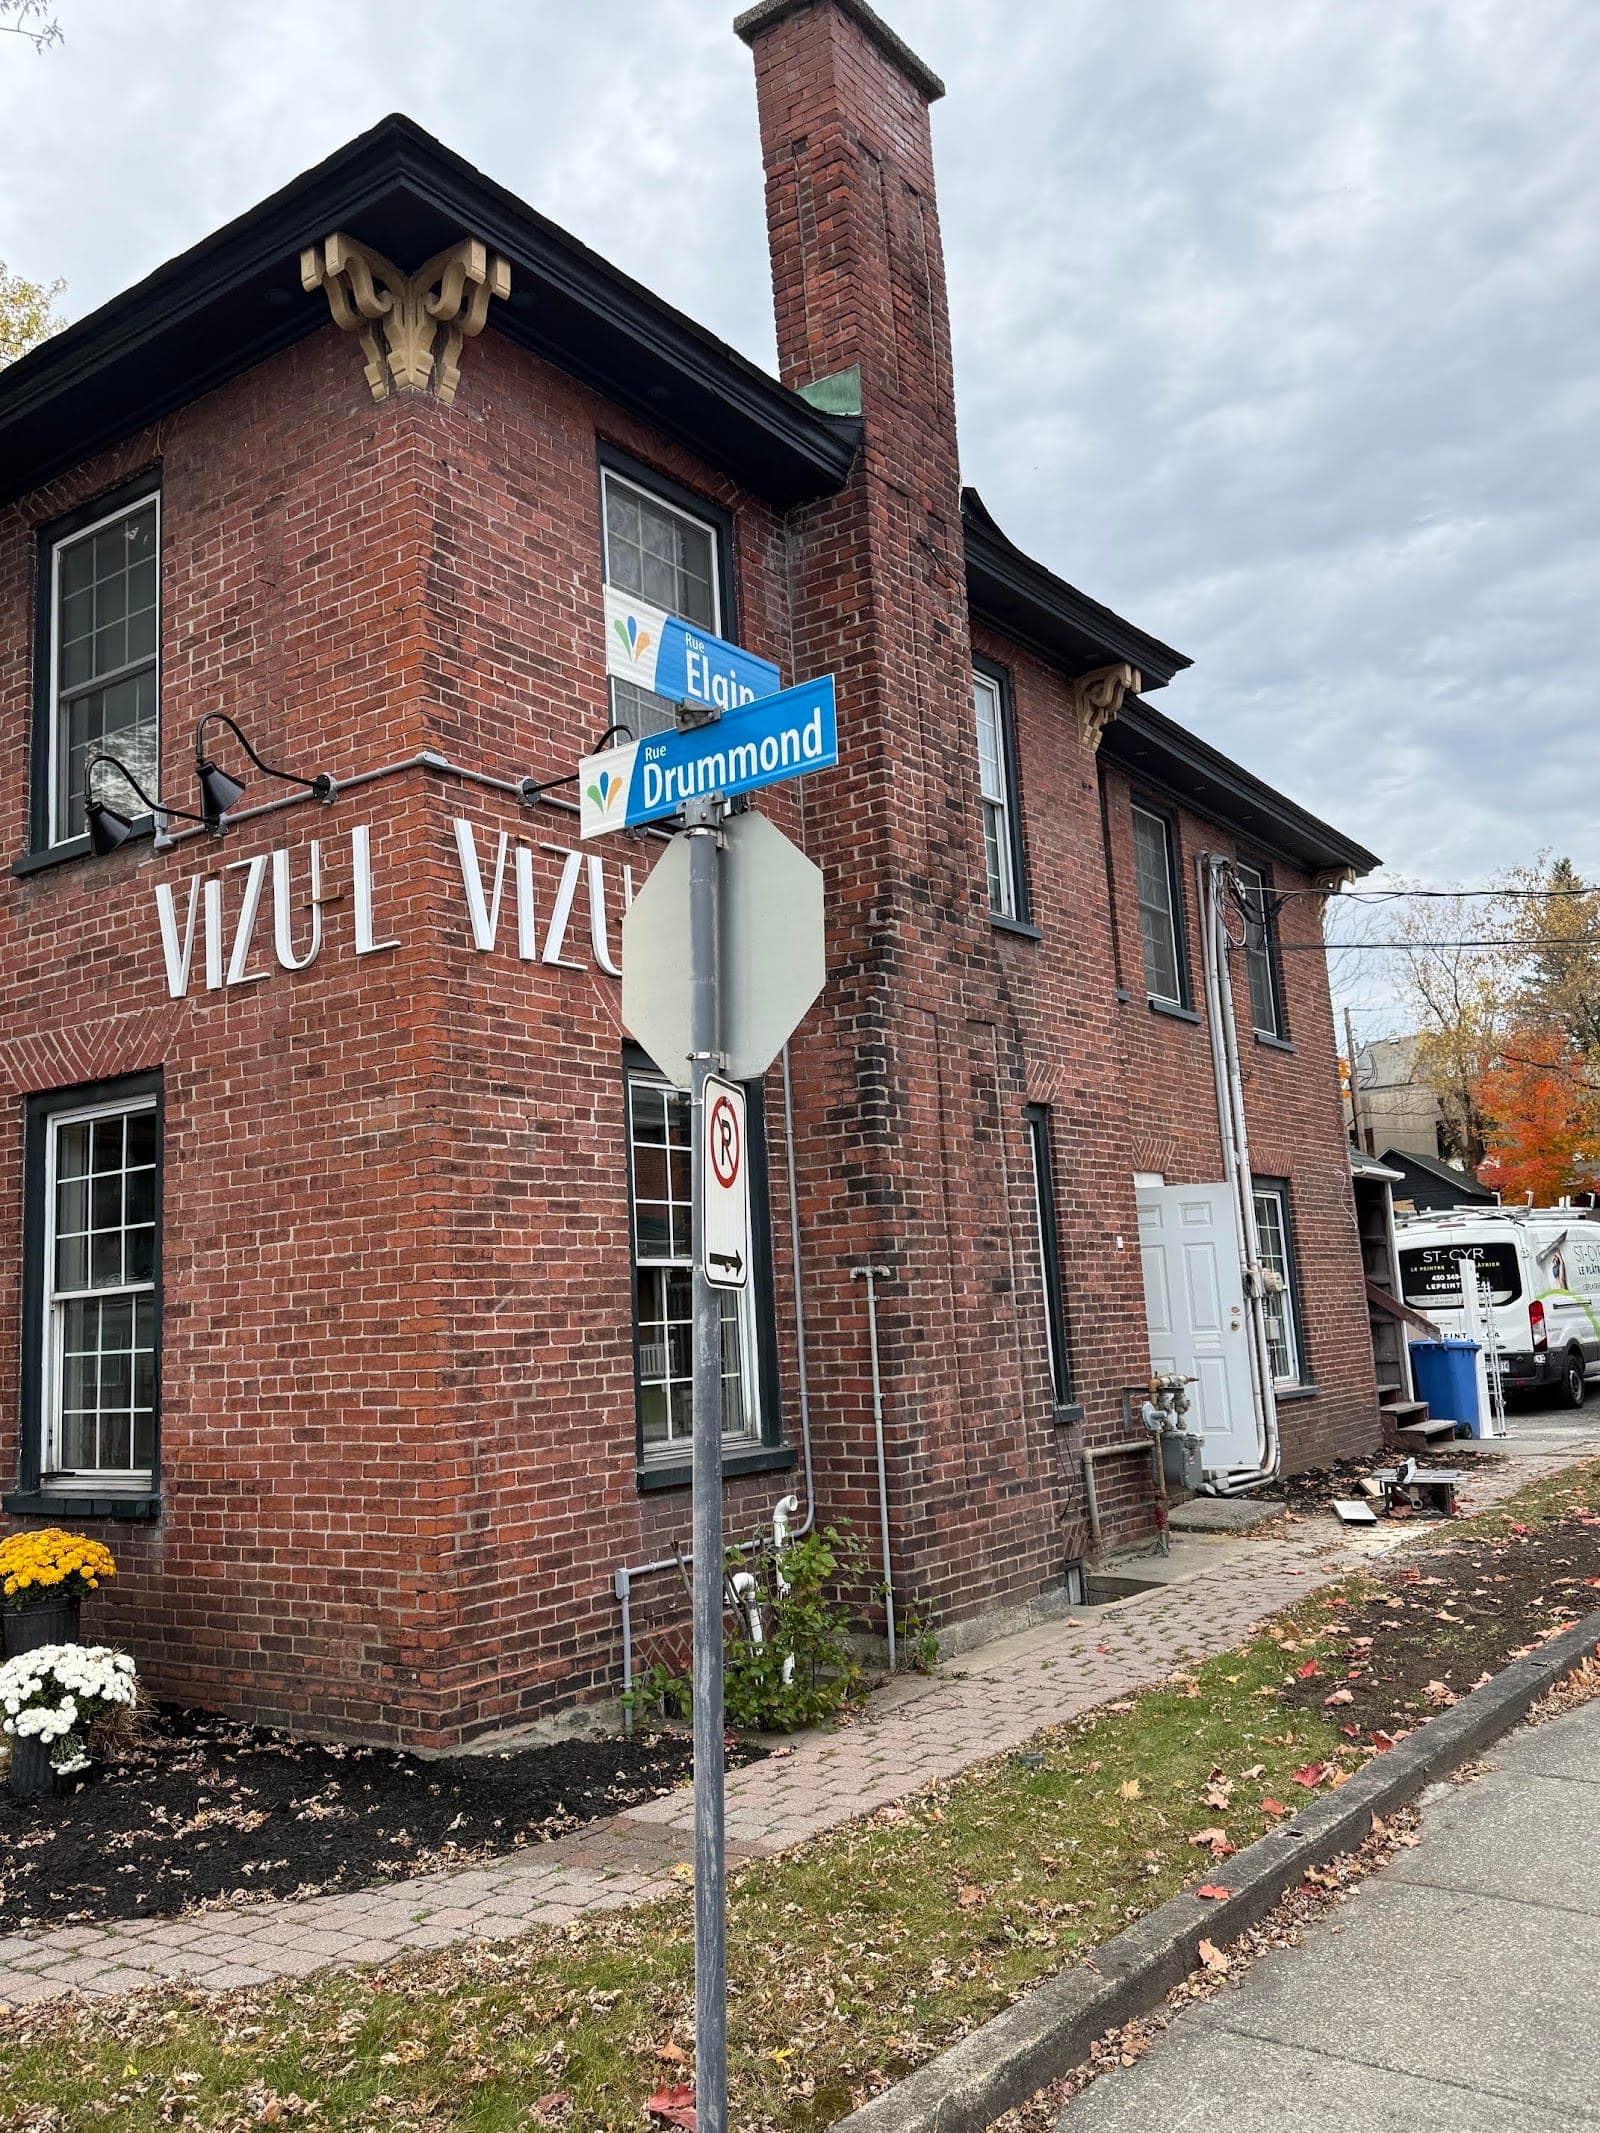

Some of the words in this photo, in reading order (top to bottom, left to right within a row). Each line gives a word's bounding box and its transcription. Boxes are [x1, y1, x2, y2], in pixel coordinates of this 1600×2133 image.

[685, 631, 705, 654] Rue
[686, 652, 756, 712] Elgin
[643, 708, 823, 809] Drummond
[644, 743, 667, 761] Rue
[1423, 1248, 1485, 1263] ST-CYR
